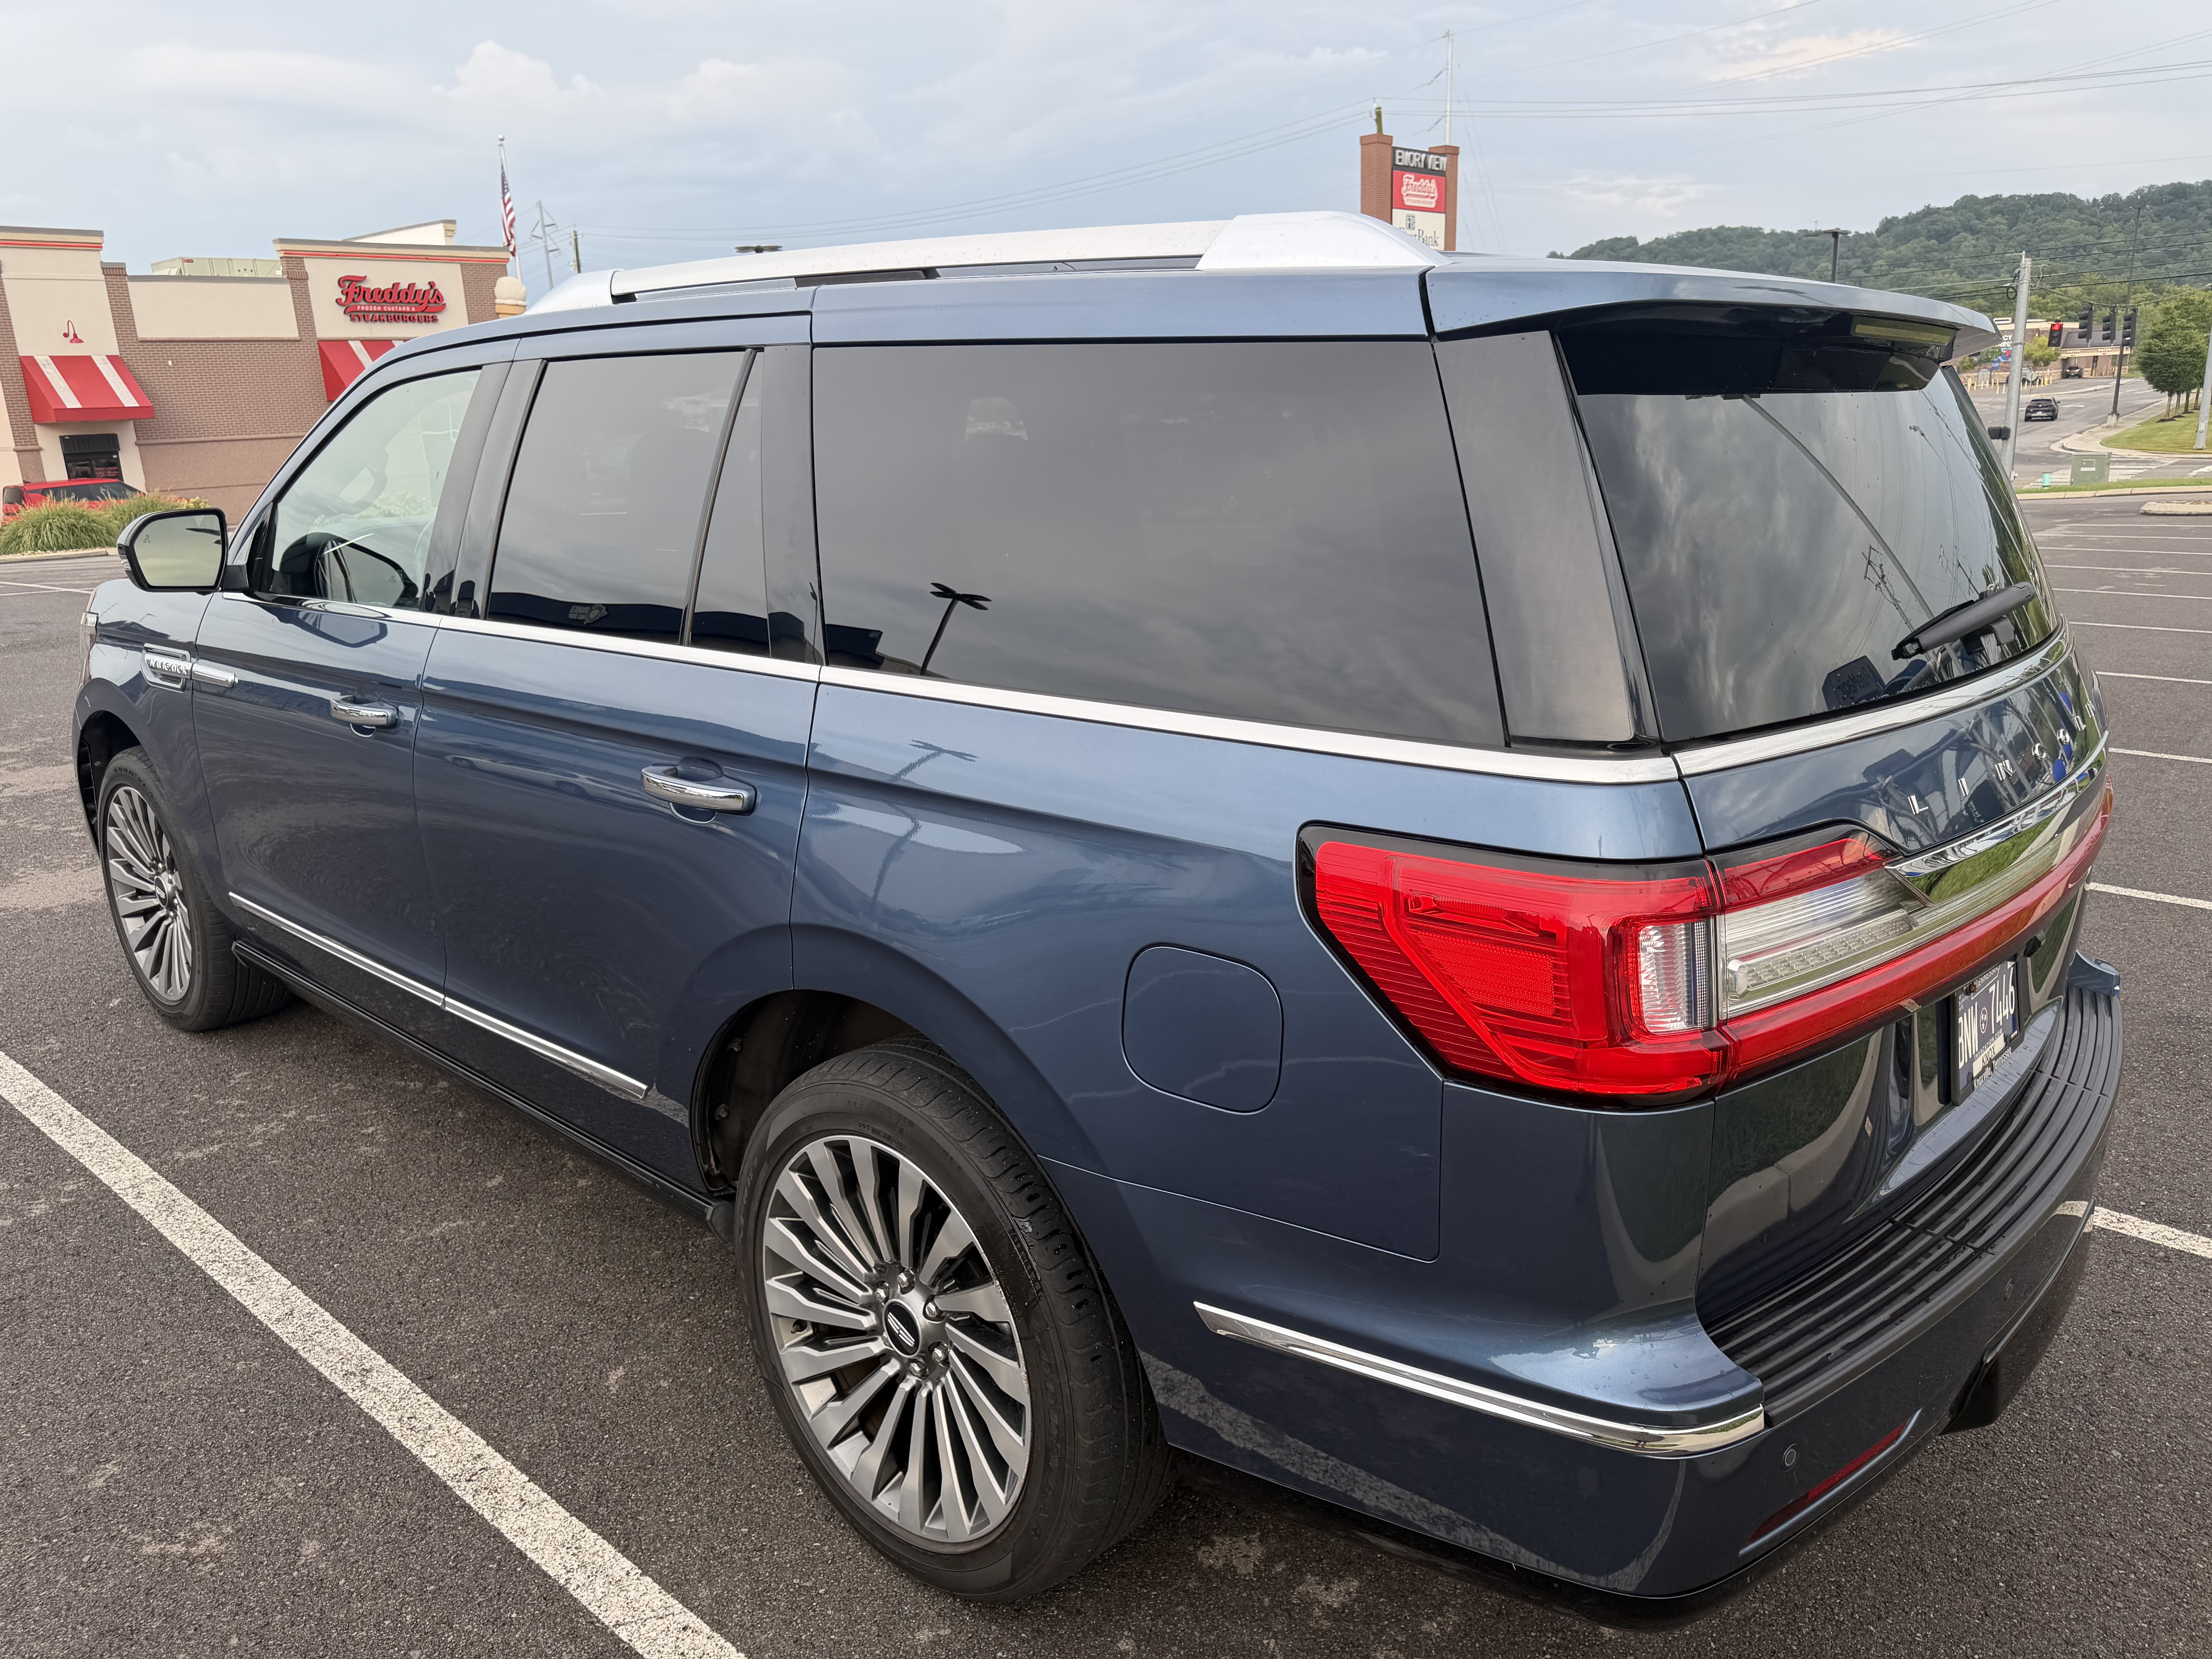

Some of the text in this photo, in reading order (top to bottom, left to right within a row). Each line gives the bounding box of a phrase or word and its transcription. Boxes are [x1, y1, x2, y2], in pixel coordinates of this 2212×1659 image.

[1395, 149, 1426, 168] EMORY
[336, 275, 446, 307] Freddy's
[350, 313, 439, 323] STEAKBURGERS
[1908, 701, 2096, 815] LINCOLN
[1959, 1002, 1978, 1070] BNW
[1989, 967, 2015, 1034] 7446
[1982, 1044, 1996, 1067] KNOX
